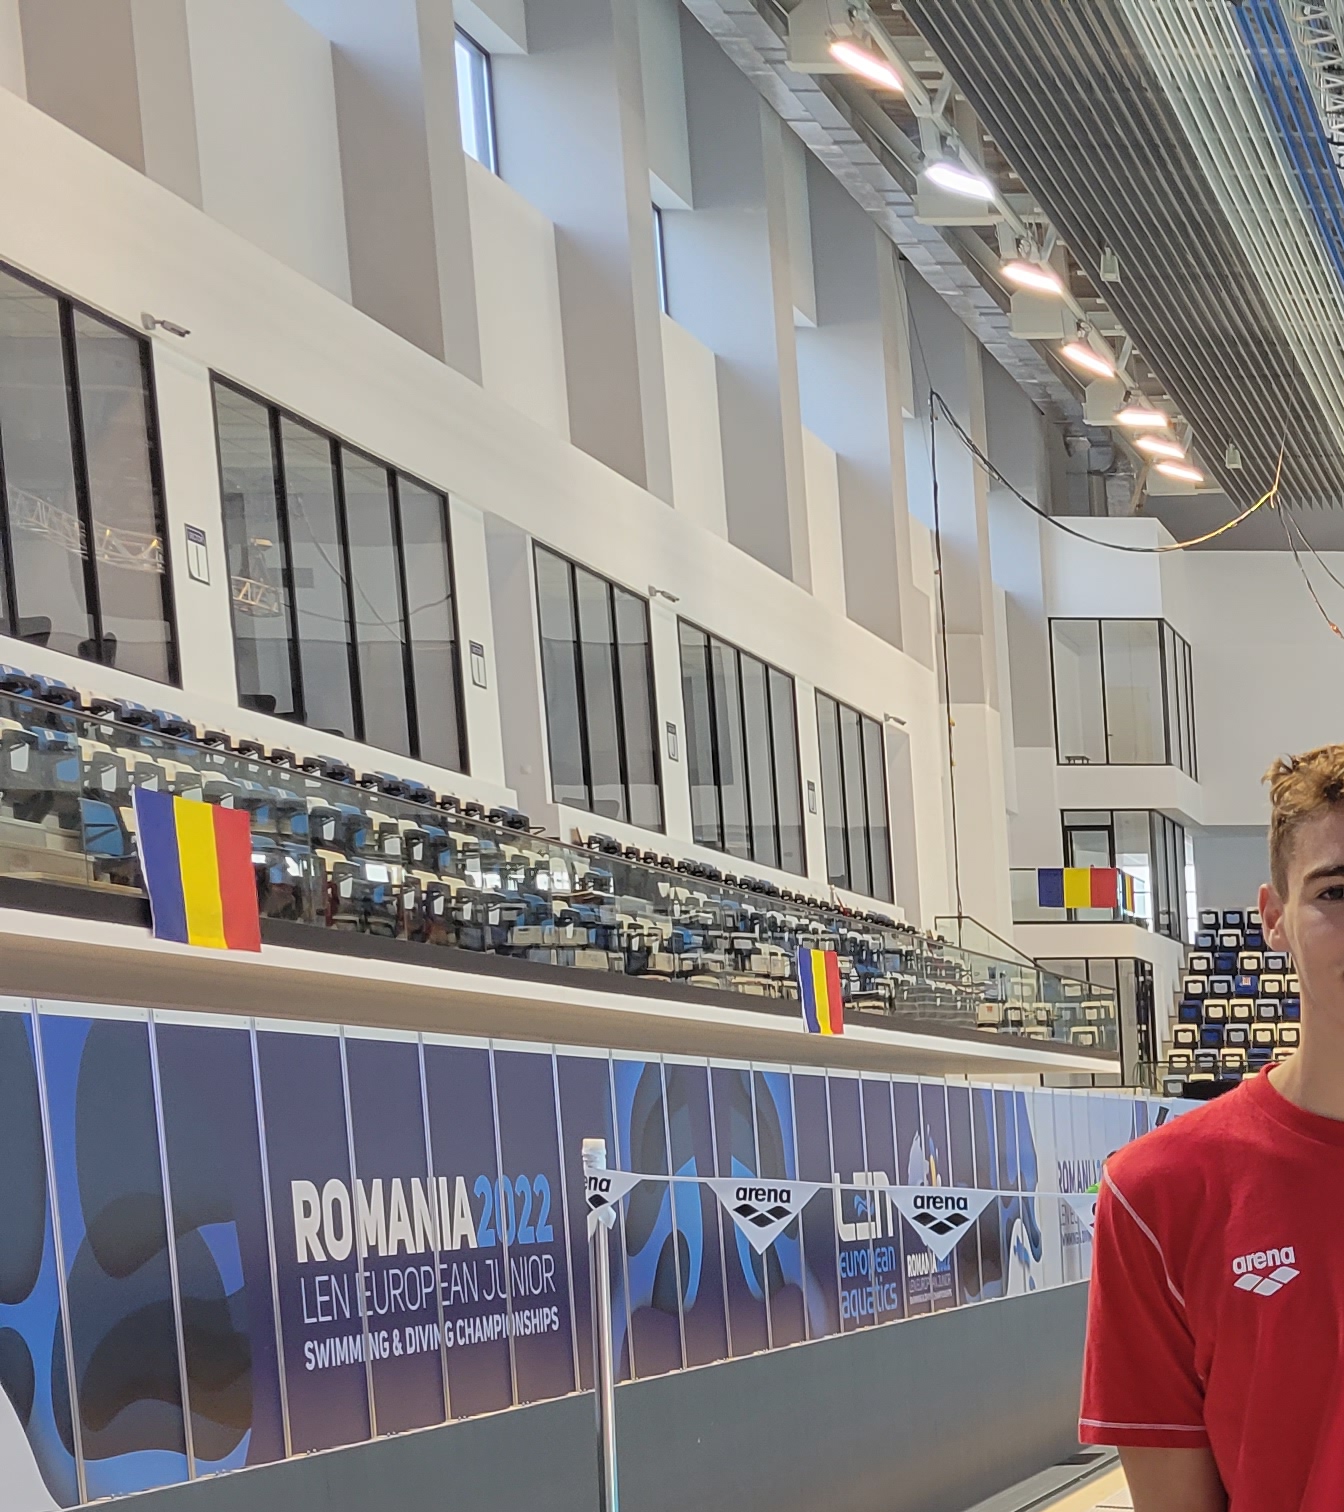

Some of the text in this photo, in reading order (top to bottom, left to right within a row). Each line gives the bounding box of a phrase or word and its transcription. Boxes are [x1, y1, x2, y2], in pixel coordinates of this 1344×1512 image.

[291, 1174, 554, 1263] ROMANIA2022
[736, 1187, 791, 1203] arena
[834, 1171, 894, 1242] LEN
[913, 1195, 968, 1211] arena
[839, 1246, 896, 1281] european
[1232, 1245, 1296, 1275] arena
[301, 1254, 556, 1323] LEN EUROPEAN JUNIOR
[841, 1275, 898, 1325] aquatics
[304, 1305, 559, 1371] SWIMMING & DIVING CHAMPIONSHIPS
